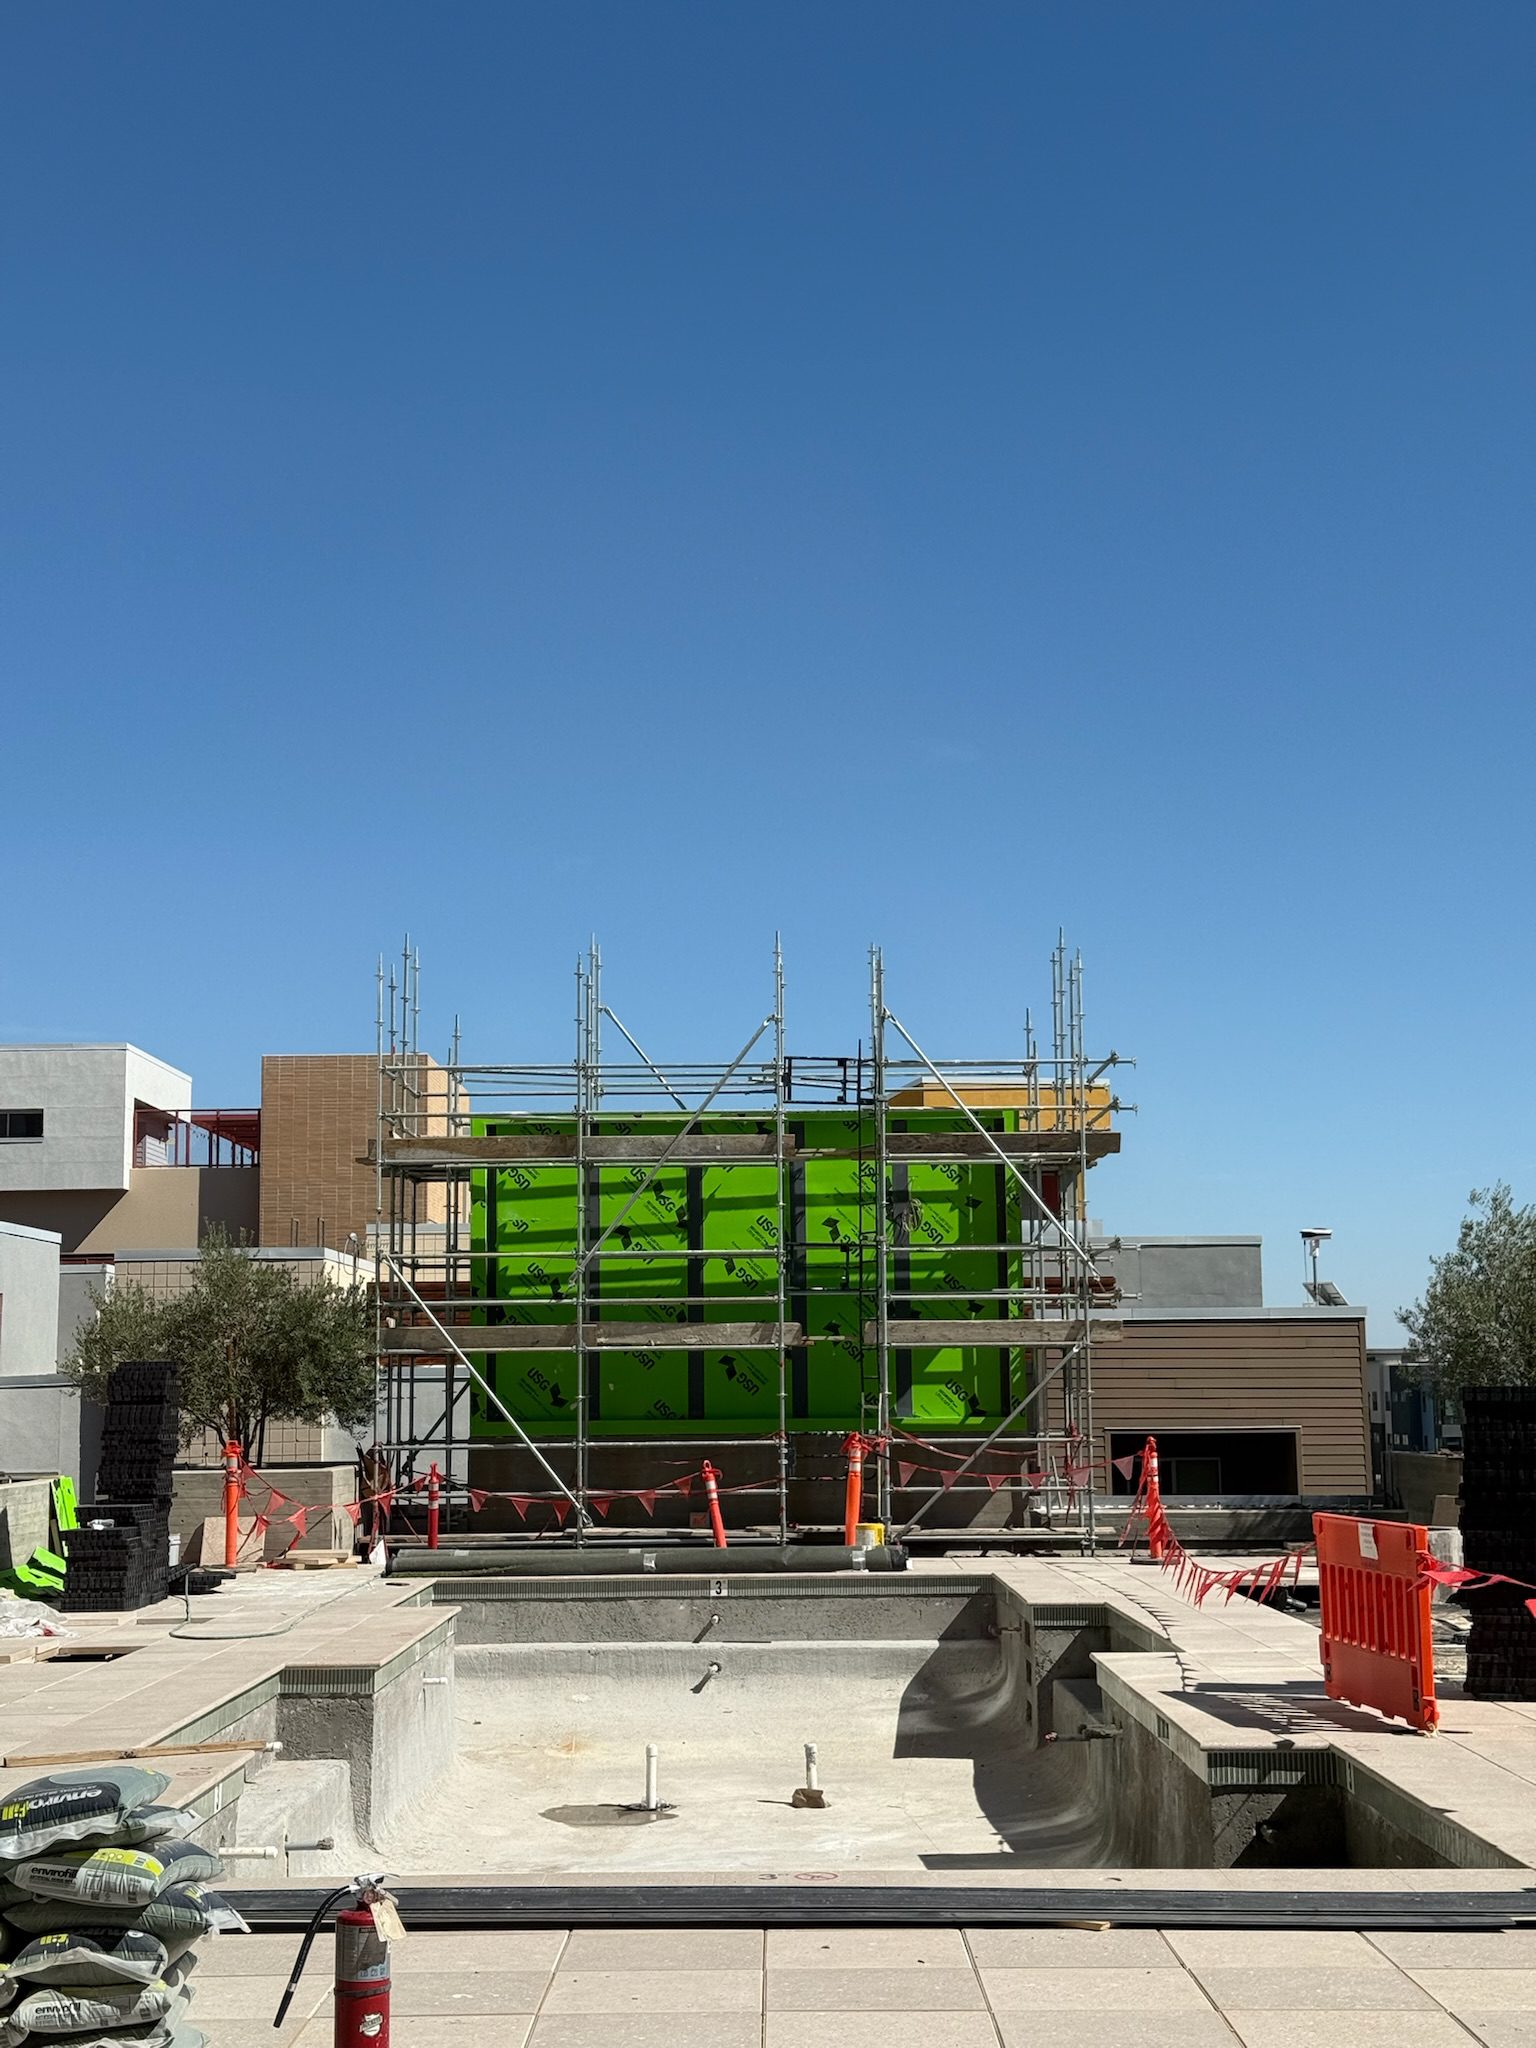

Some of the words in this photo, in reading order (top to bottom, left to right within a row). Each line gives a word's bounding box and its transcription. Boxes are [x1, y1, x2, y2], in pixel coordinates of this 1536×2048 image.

[508, 1167, 531, 1191] USG
[940, 1164, 962, 1186] USG
[755, 1215, 778, 1238] USG
[921, 1221, 944, 1245] USG
[527, 1262, 550, 1286] USG
[736, 1267, 759, 1291] USG
[527, 1367, 550, 1391] USG
[737, 1372, 760, 1396] USG
[945, 1378, 968, 1402] USG
[715, 1580, 722, 1595] 3
